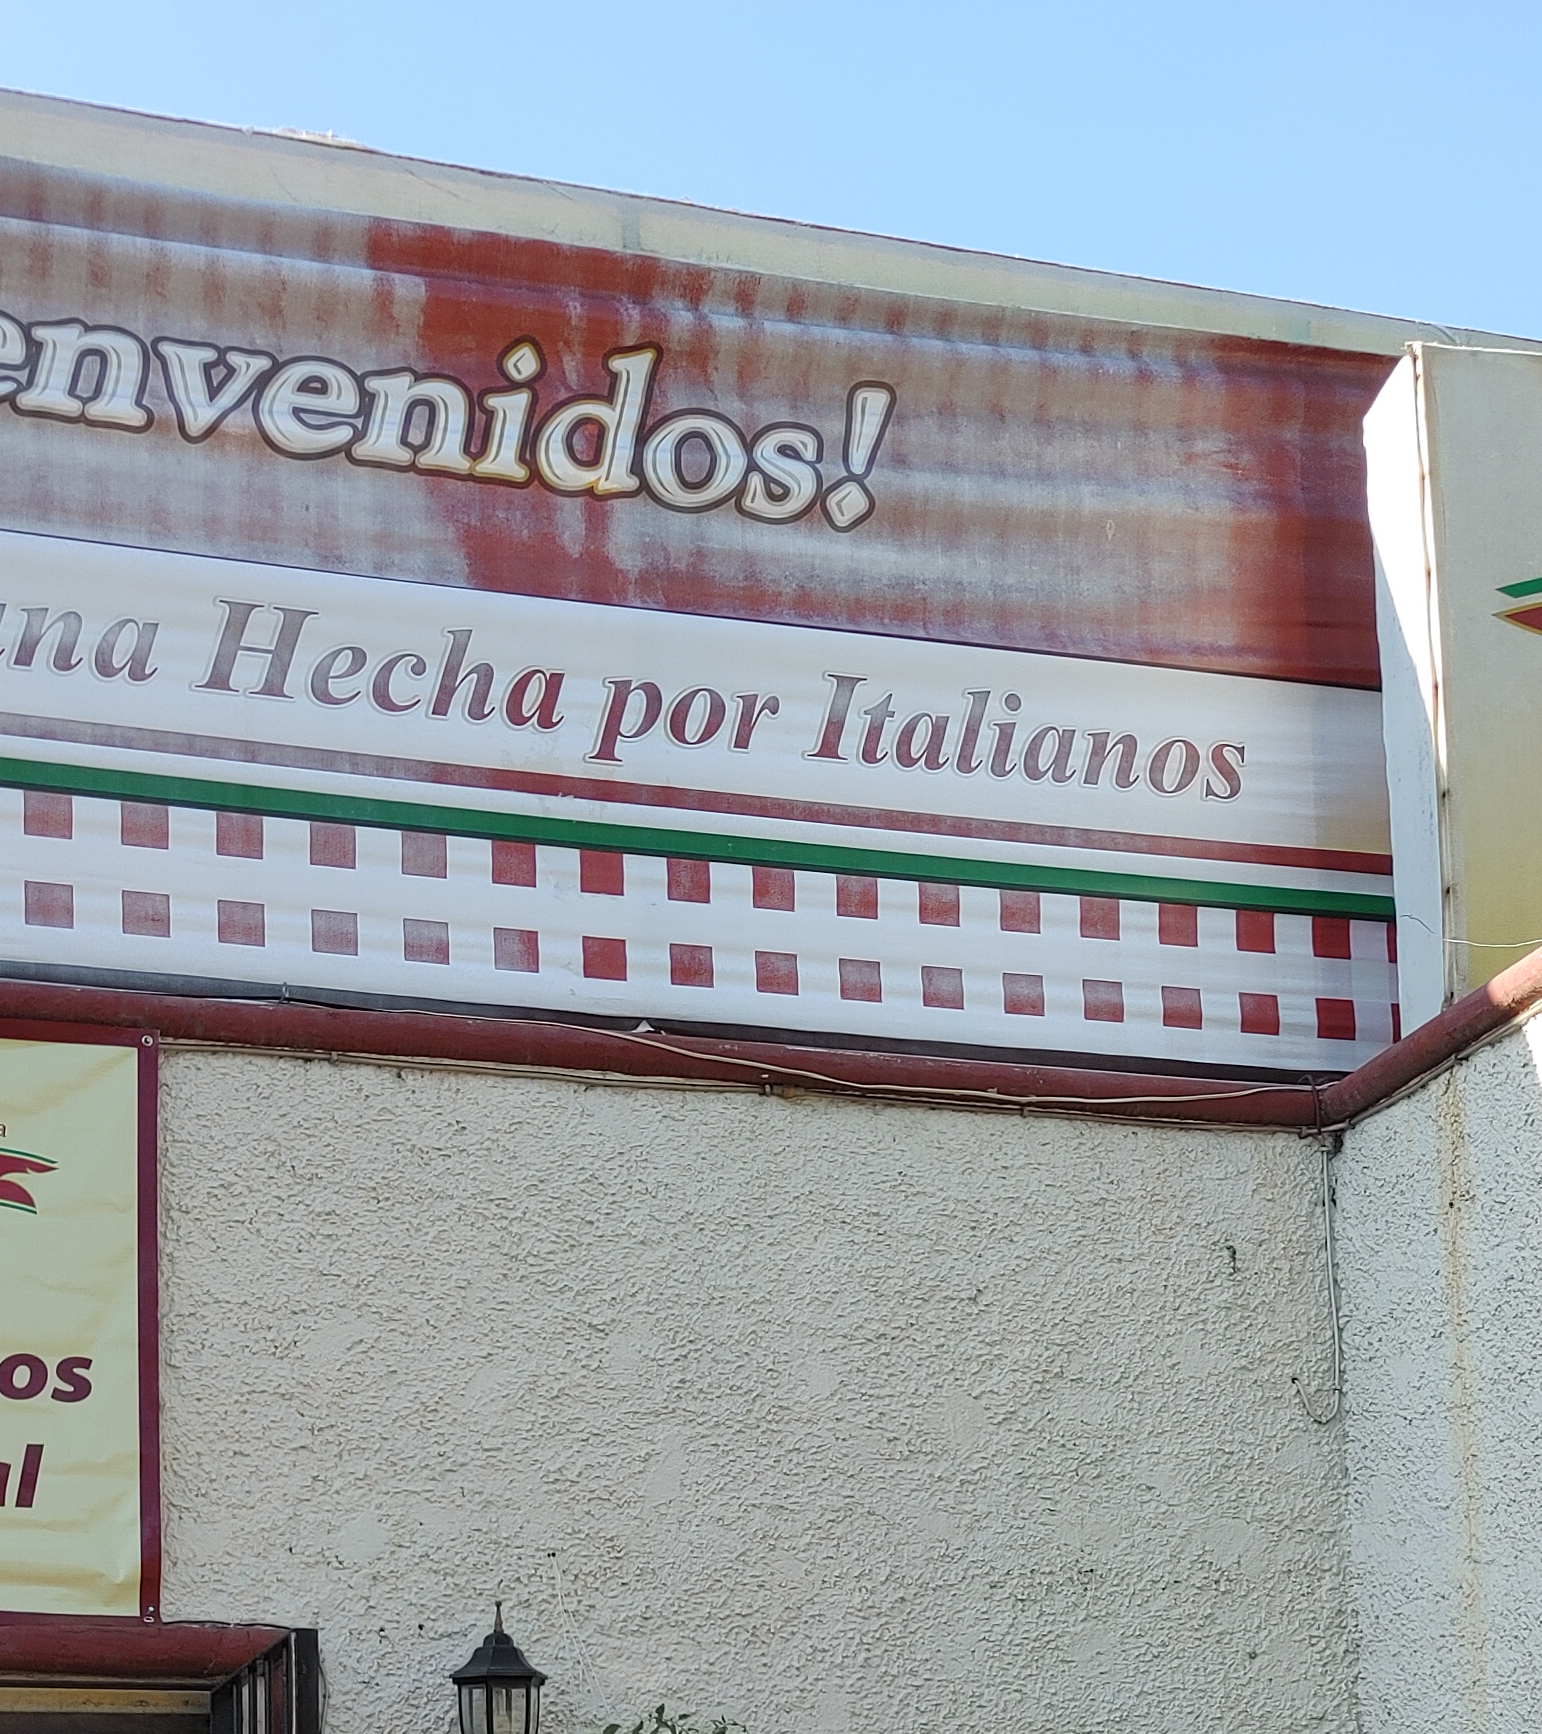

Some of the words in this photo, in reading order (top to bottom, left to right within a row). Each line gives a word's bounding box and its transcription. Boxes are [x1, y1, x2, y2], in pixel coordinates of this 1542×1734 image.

[195, 600, 566, 731] Hecha
[587, 675, 781, 764] por
[807, 671, 1247, 803] Italianos
